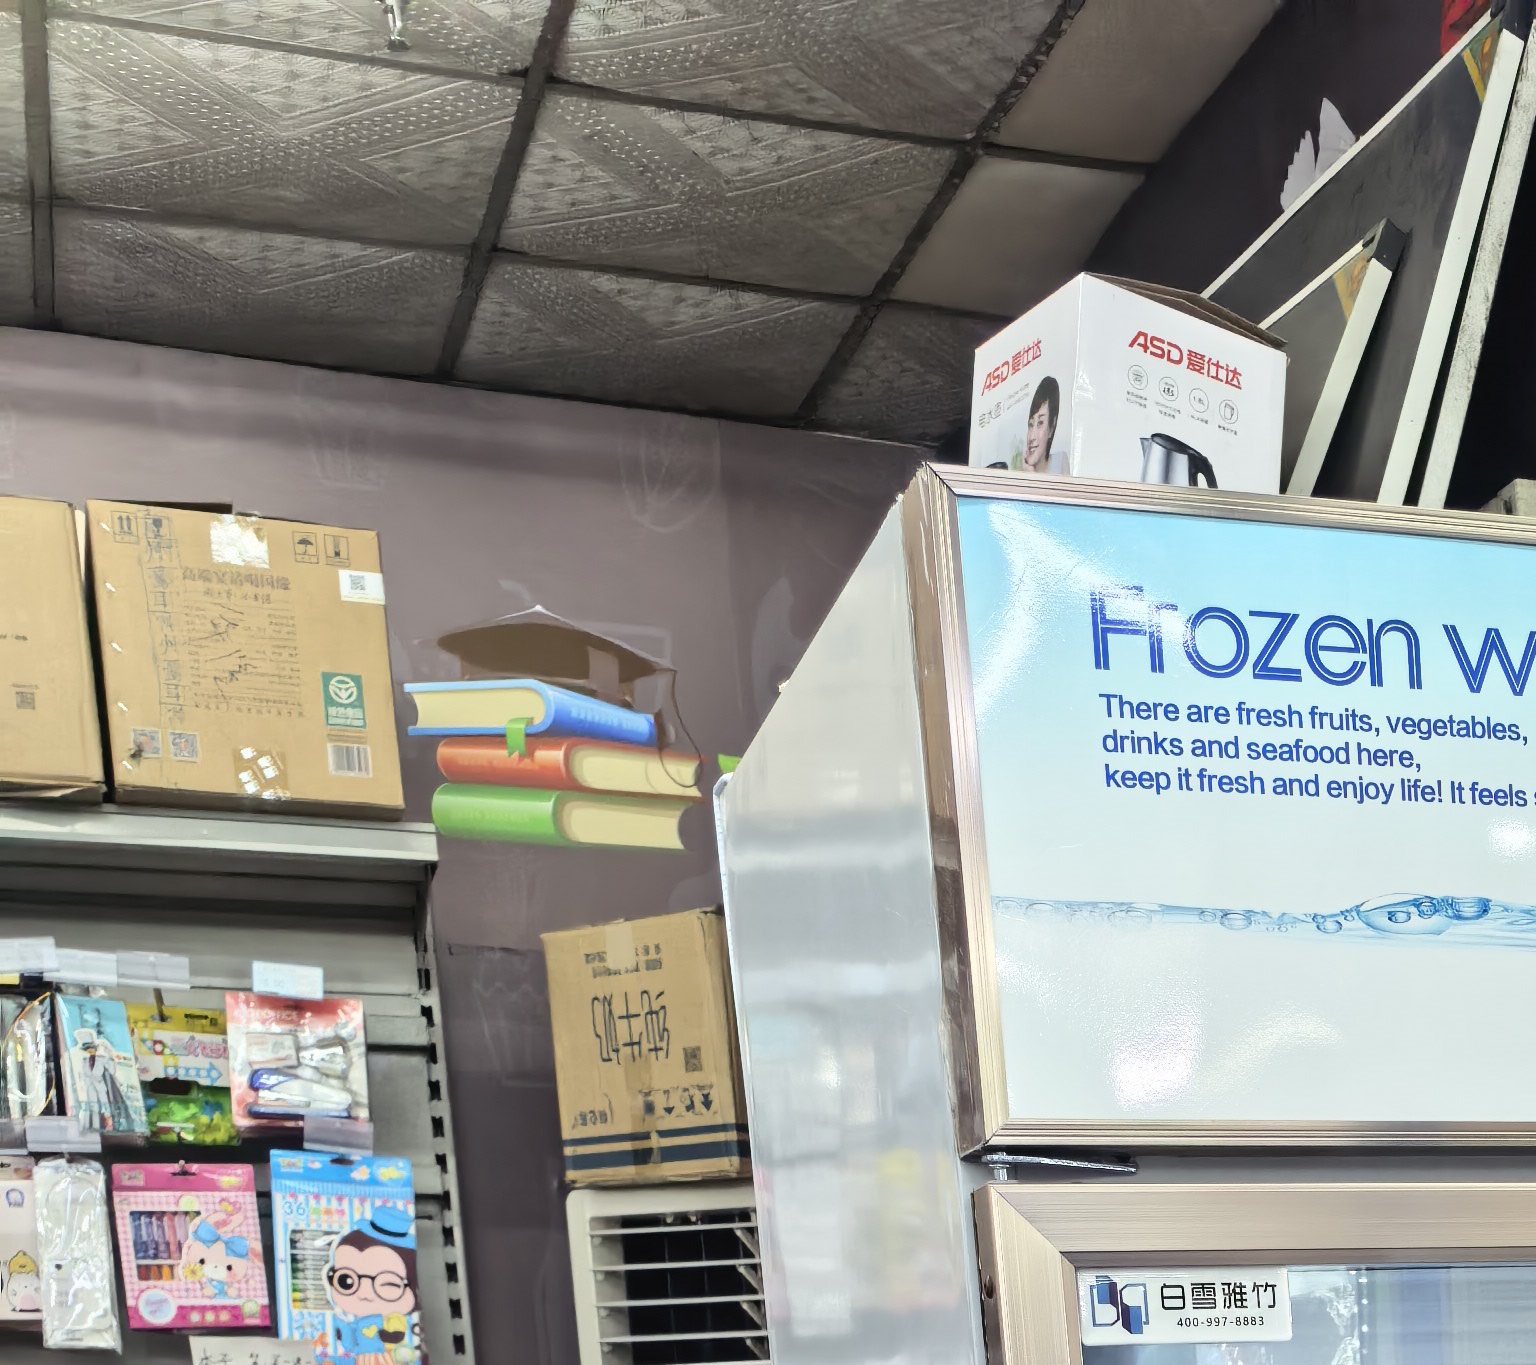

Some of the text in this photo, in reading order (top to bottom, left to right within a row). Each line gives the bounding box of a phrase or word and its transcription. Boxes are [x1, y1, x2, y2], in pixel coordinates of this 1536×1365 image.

[981, 337, 1042, 396] ASD 爱仕达
[1128, 330, 1242, 390] ASD 爱仕达
[1090, 585, 1422, 689] Frozen
[1099, 693, 1528, 746] There are fresh fruits, vegetables,
[1102, 729, 1421, 772] drinks and seafood here,
[1104, 763, 1171, 795] keep
[1177, 767, 1191, 791] it
[1198, 768, 1265, 795] fresh
[1272, 774, 1320, 797] and
[1326, 779, 1394, 804] enjoy
[1400, 778, 1443, 803] life!
[1450, 780, 1465, 804] It
[1469, 782, 1528, 807] feels
[591, 989, 670, 1066] 纯牛奶
[1161, 1282, 1277, 1311] 白雪雅竹
[1177, 1316, 1265, 1328] 400-997-8883
